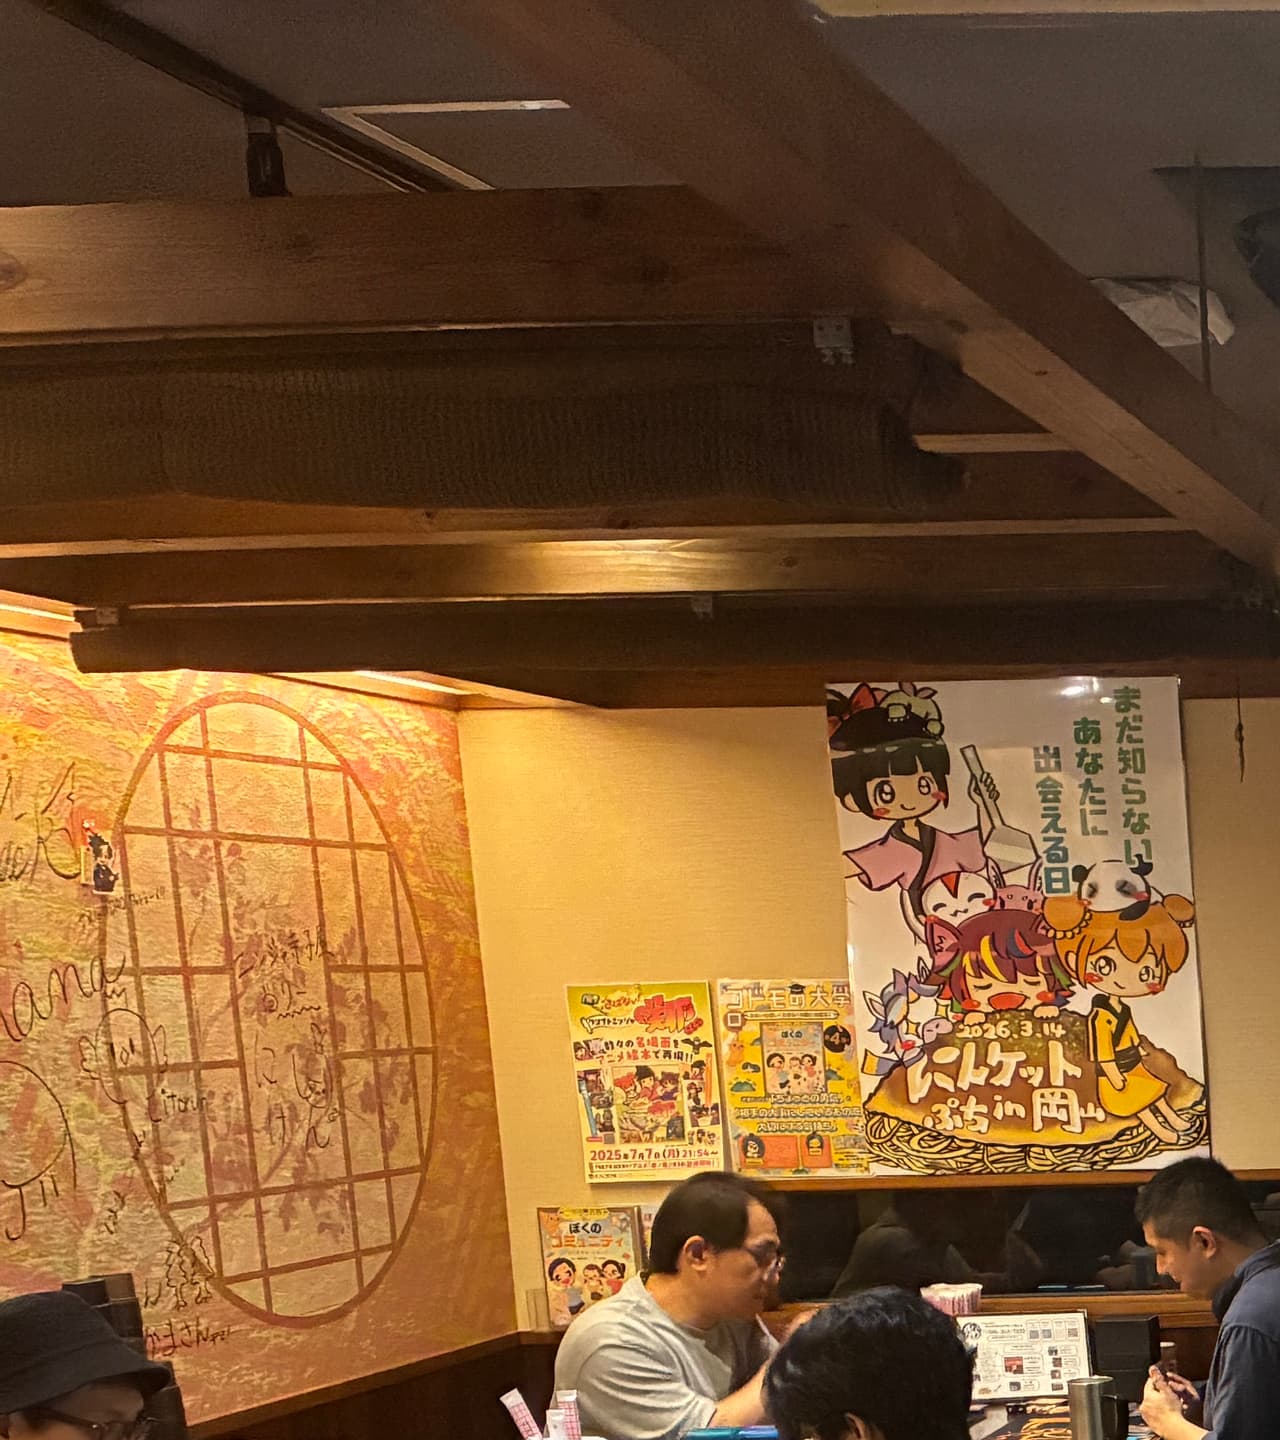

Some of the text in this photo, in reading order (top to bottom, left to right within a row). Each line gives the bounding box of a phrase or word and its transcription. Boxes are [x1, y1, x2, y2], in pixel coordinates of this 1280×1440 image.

[1033, 745, 1071, 895] 出会える日
[1072, 717, 1109, 837] あなたに
[1113, 686, 1153, 866] まだ知らない
[906, 1040, 1082, 1104] にんケット
[955, 1019, 1067, 1039] 2026.3.14
[569, 1222, 602, 1234] ぼくの
